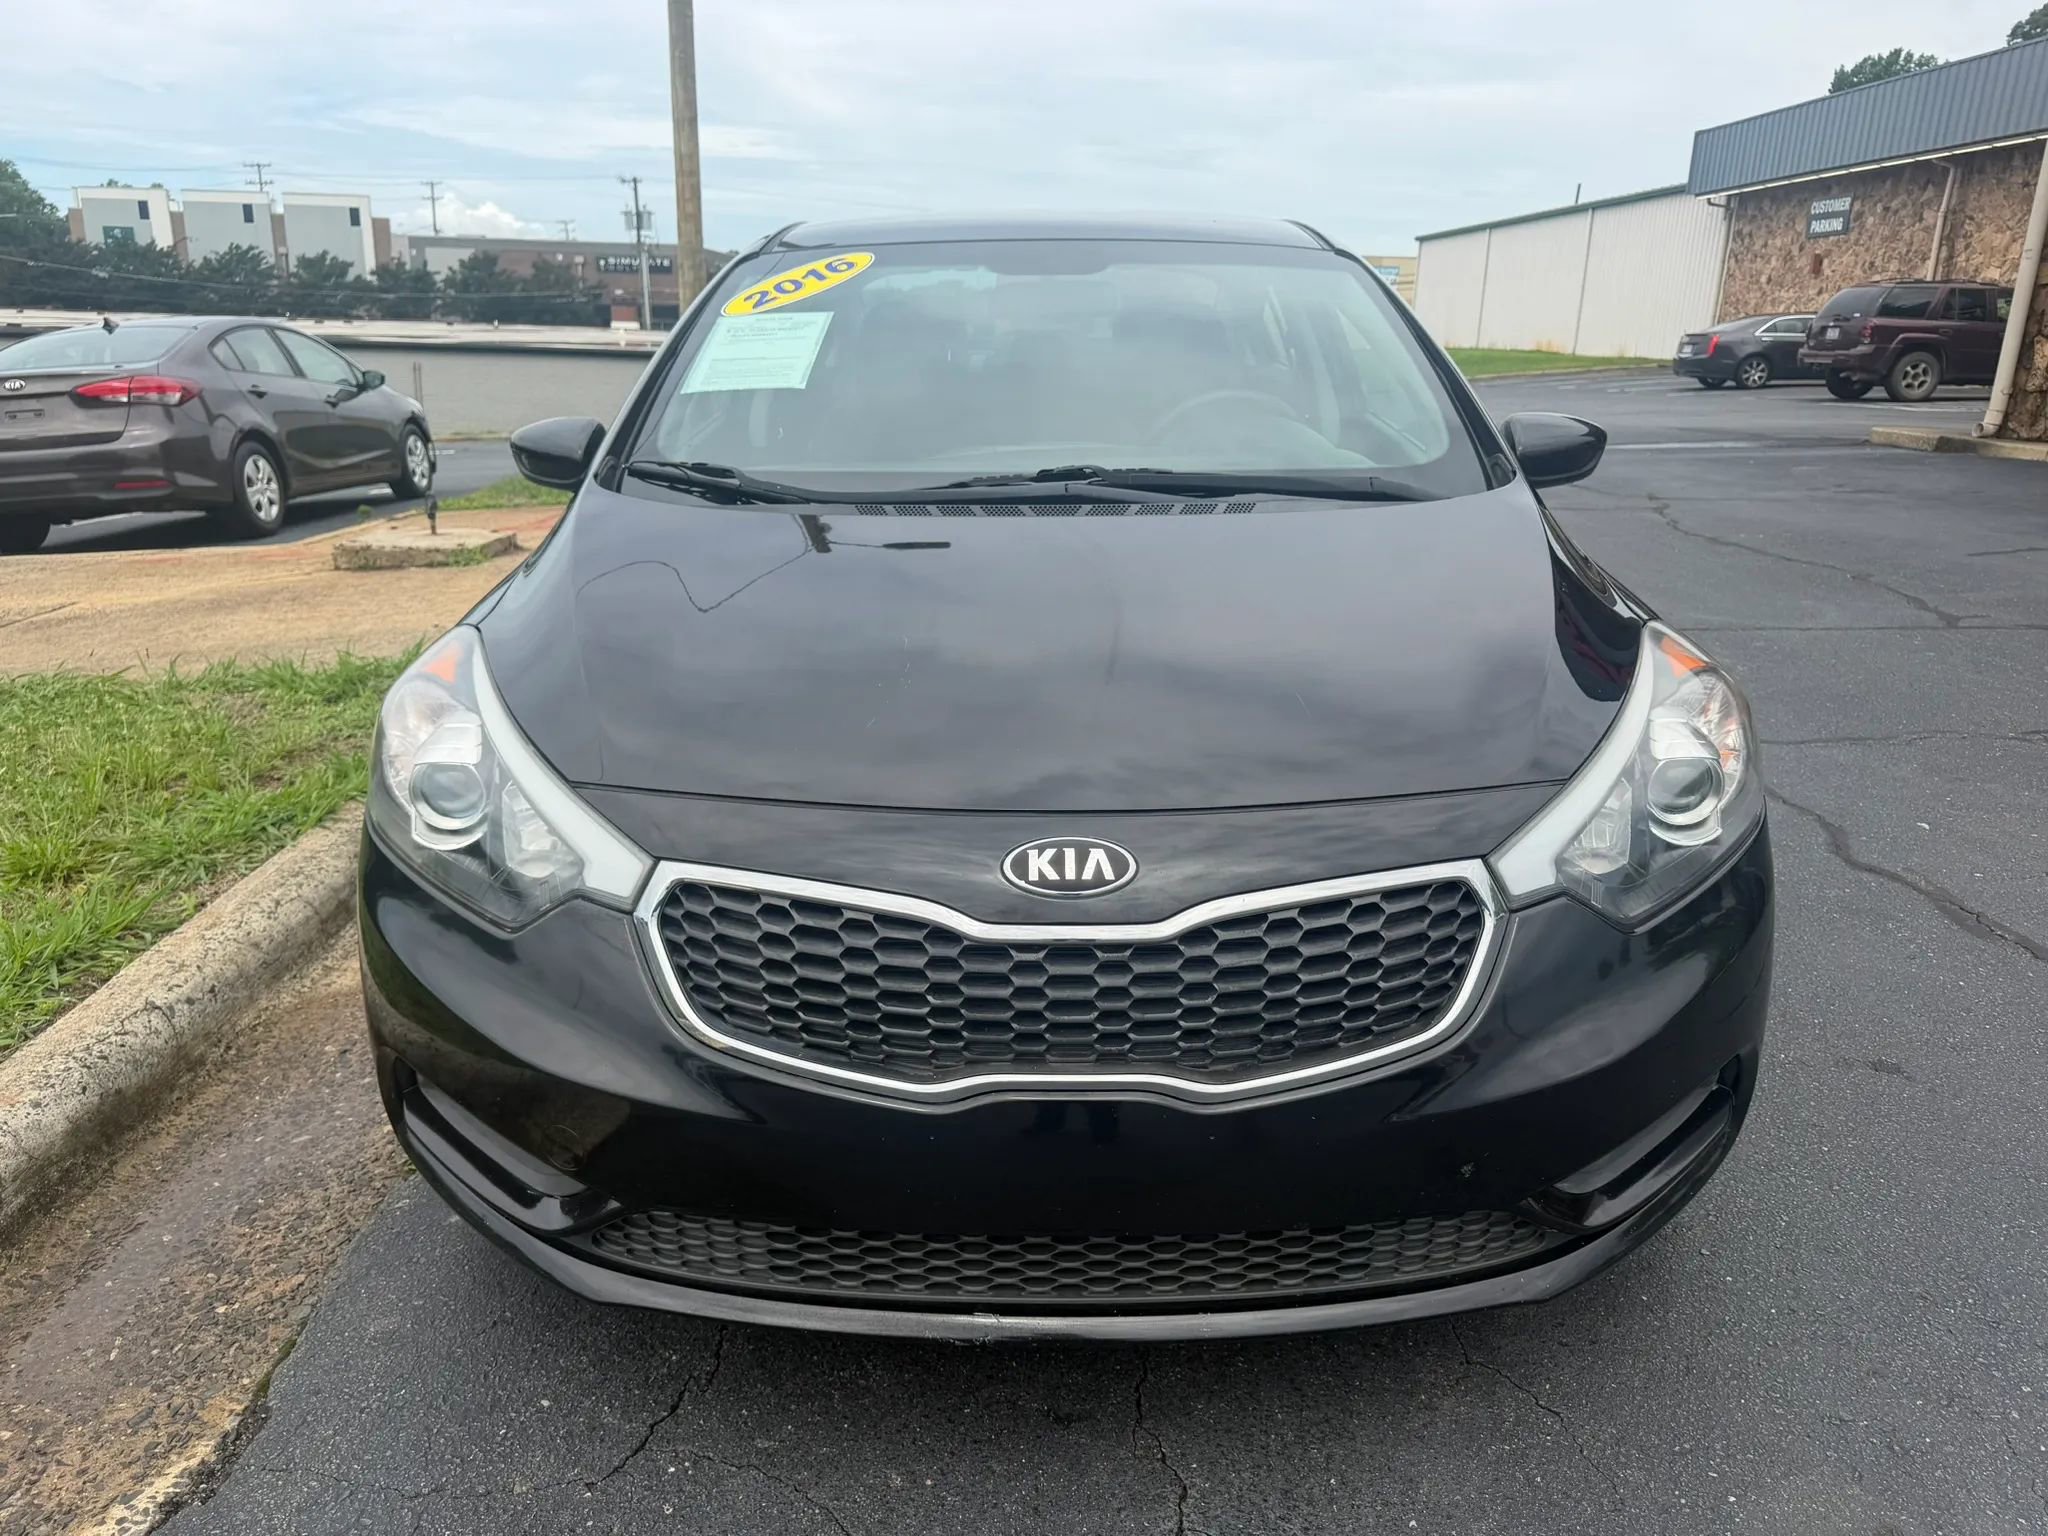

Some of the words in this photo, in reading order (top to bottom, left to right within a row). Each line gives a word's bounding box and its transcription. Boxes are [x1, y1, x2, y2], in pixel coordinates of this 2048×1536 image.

[1811, 197, 1851, 215] CUSTOMER
[1810, 217, 1843, 234] PARKING
[607, 256, 671, 267] SIMUATE
[743, 257, 857, 310] 2016
[1026, 847, 1116, 881] KIA
